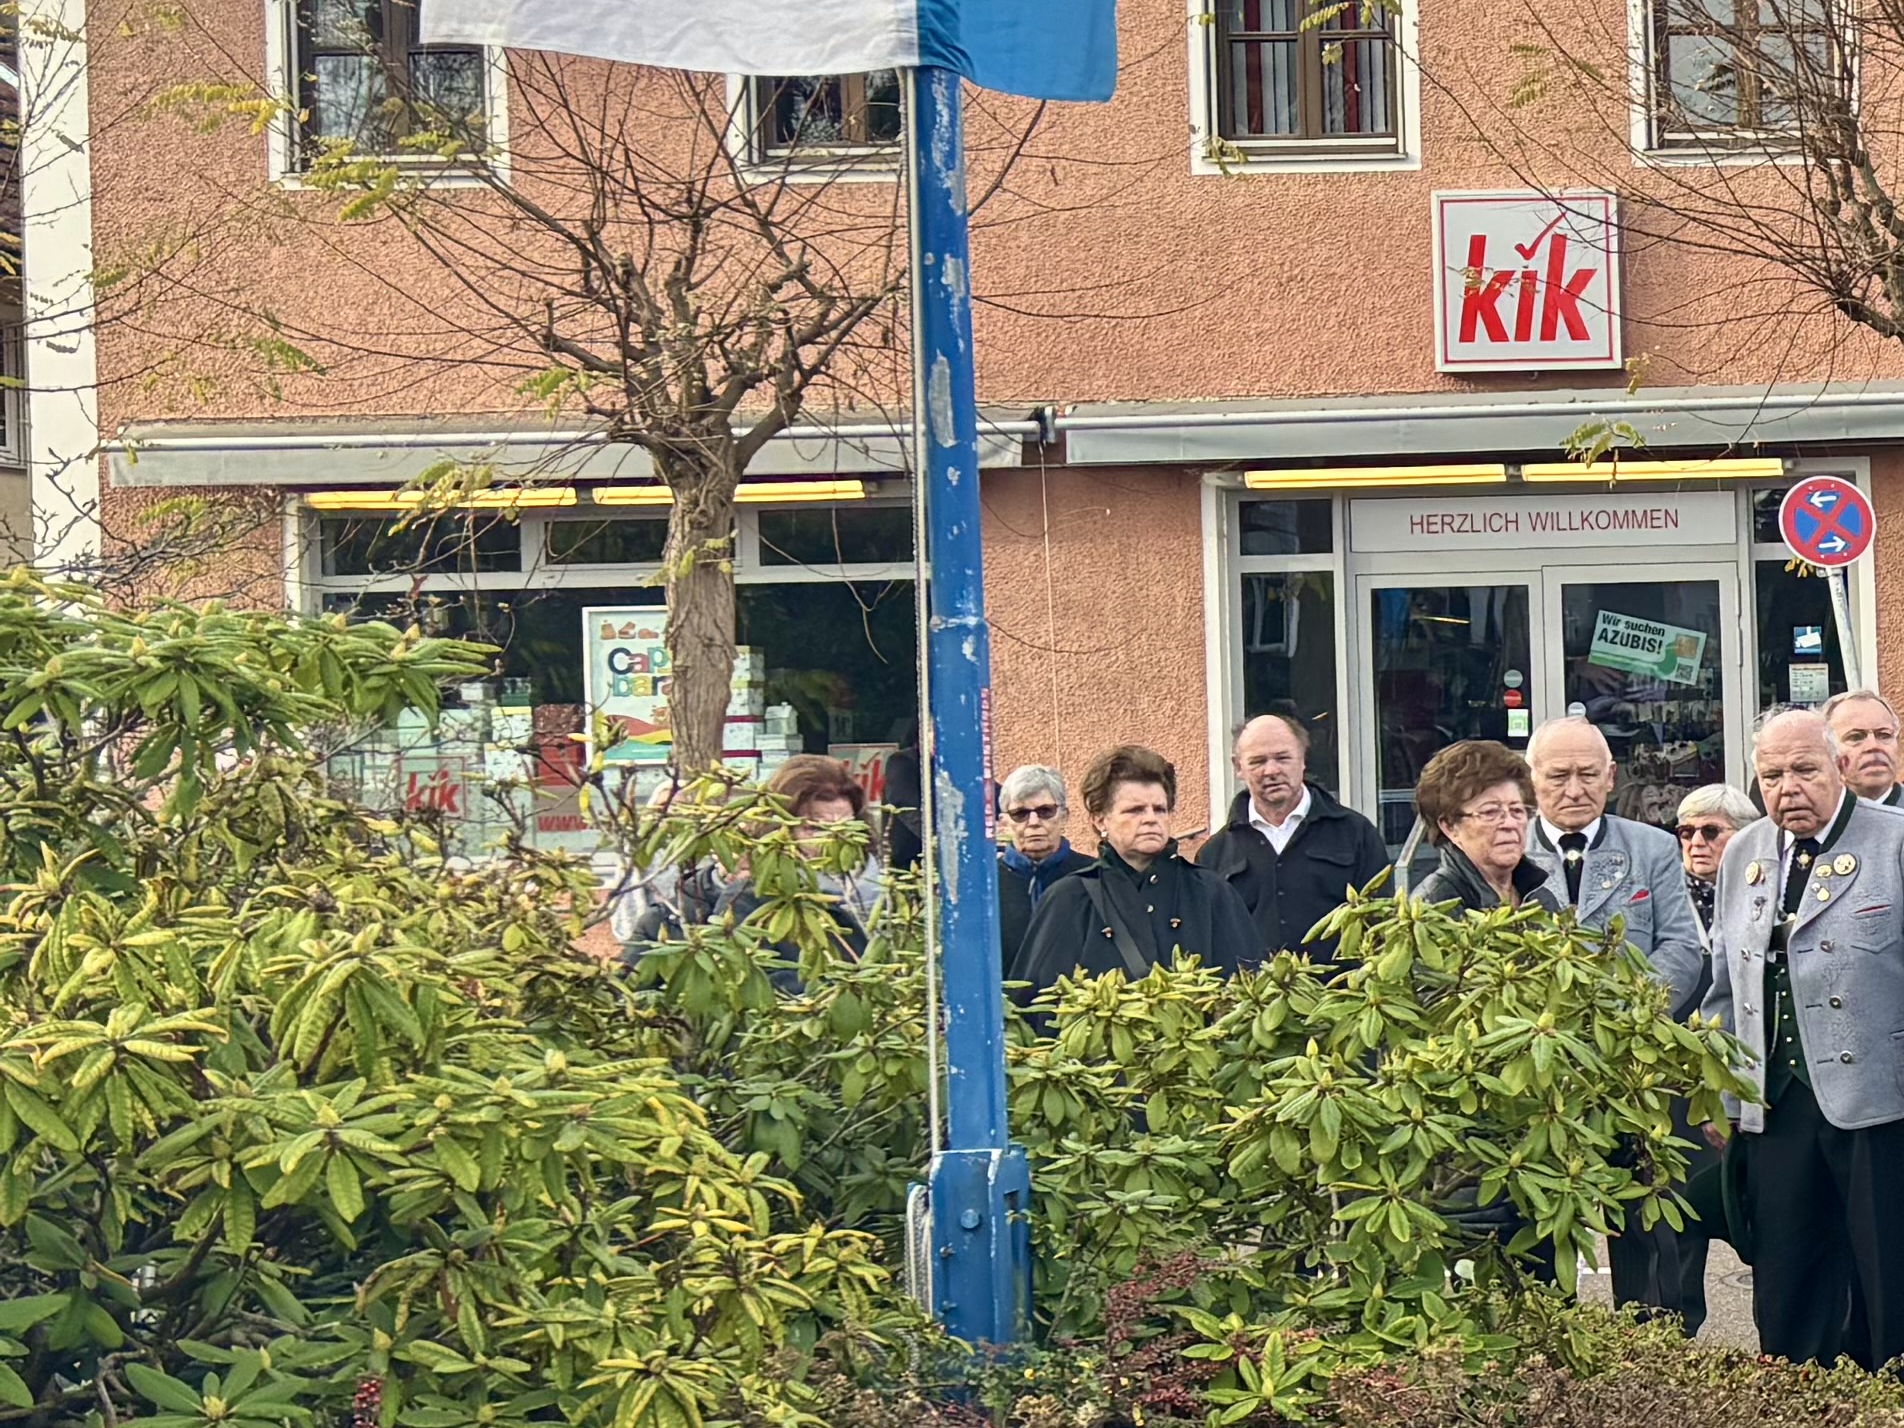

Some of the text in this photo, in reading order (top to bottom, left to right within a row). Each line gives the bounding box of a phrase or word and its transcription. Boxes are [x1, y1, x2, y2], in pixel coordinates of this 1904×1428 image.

[1459, 210, 1597, 343] kik
[1409, 508, 1679, 534] HERZLICH WILLKOMMEN
[1602, 613, 1665, 637] Wir suchen
[1597, 627, 1663, 654] AZUBIS!
[406, 766, 460, 813] kik
